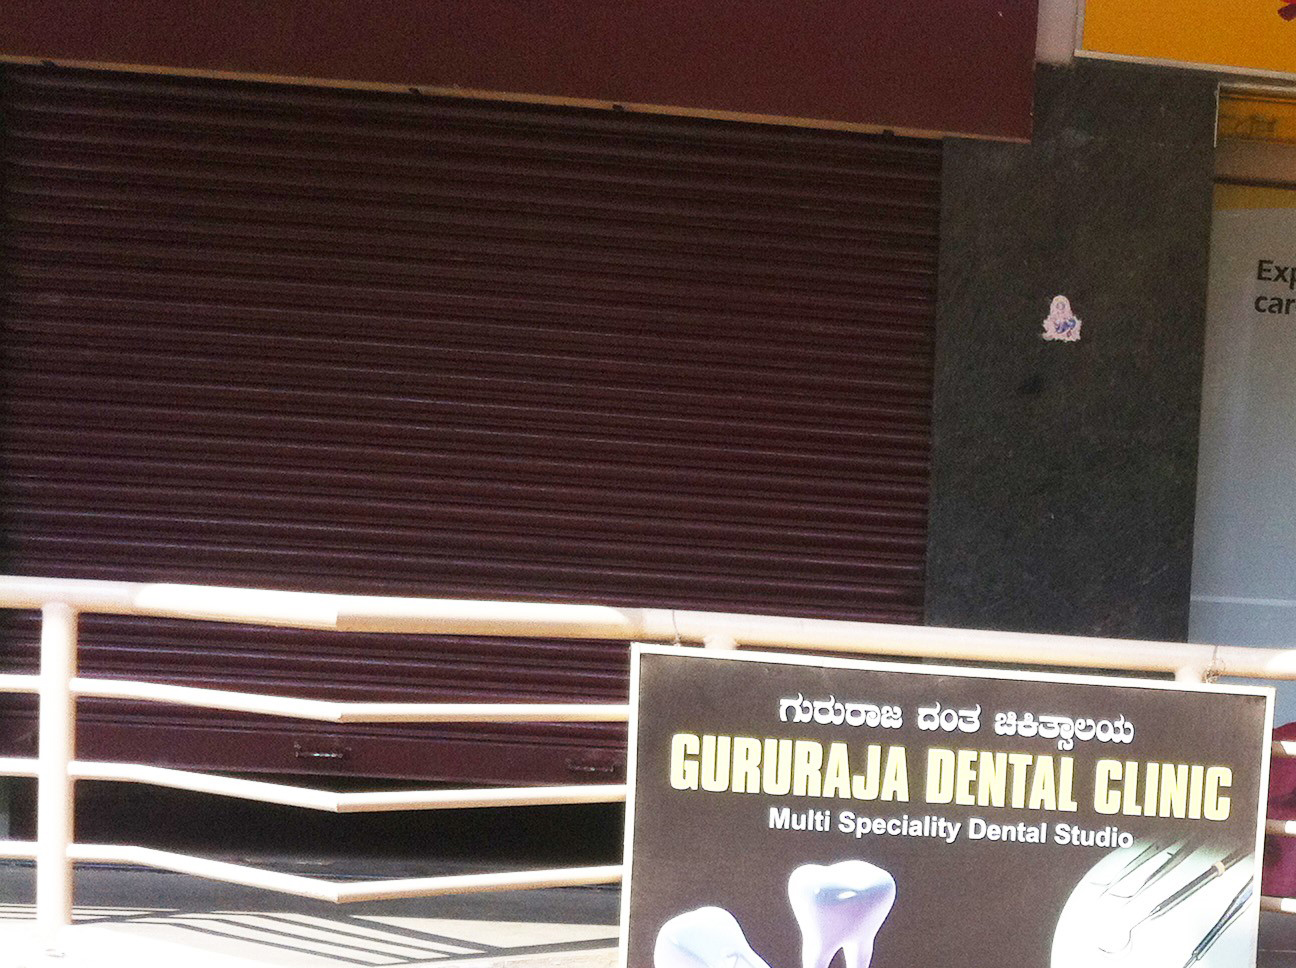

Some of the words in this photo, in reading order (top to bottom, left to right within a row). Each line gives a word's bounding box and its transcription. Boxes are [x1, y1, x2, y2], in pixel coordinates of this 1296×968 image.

[779, 693, 903, 729] ಗುರುರಾಜ
[917, 701, 982, 733] ದಂತ
[670, 734, 910, 804] GURURAJA
[926, 748, 1078, 813] DENTAL
[1093, 759, 1233, 822] CLINIC
[768, 807, 831, 832] Multi
[838, 811, 961, 844] Speciality
[968, 818, 1047, 844] Dental
[1054, 823, 1134, 849] Studio
